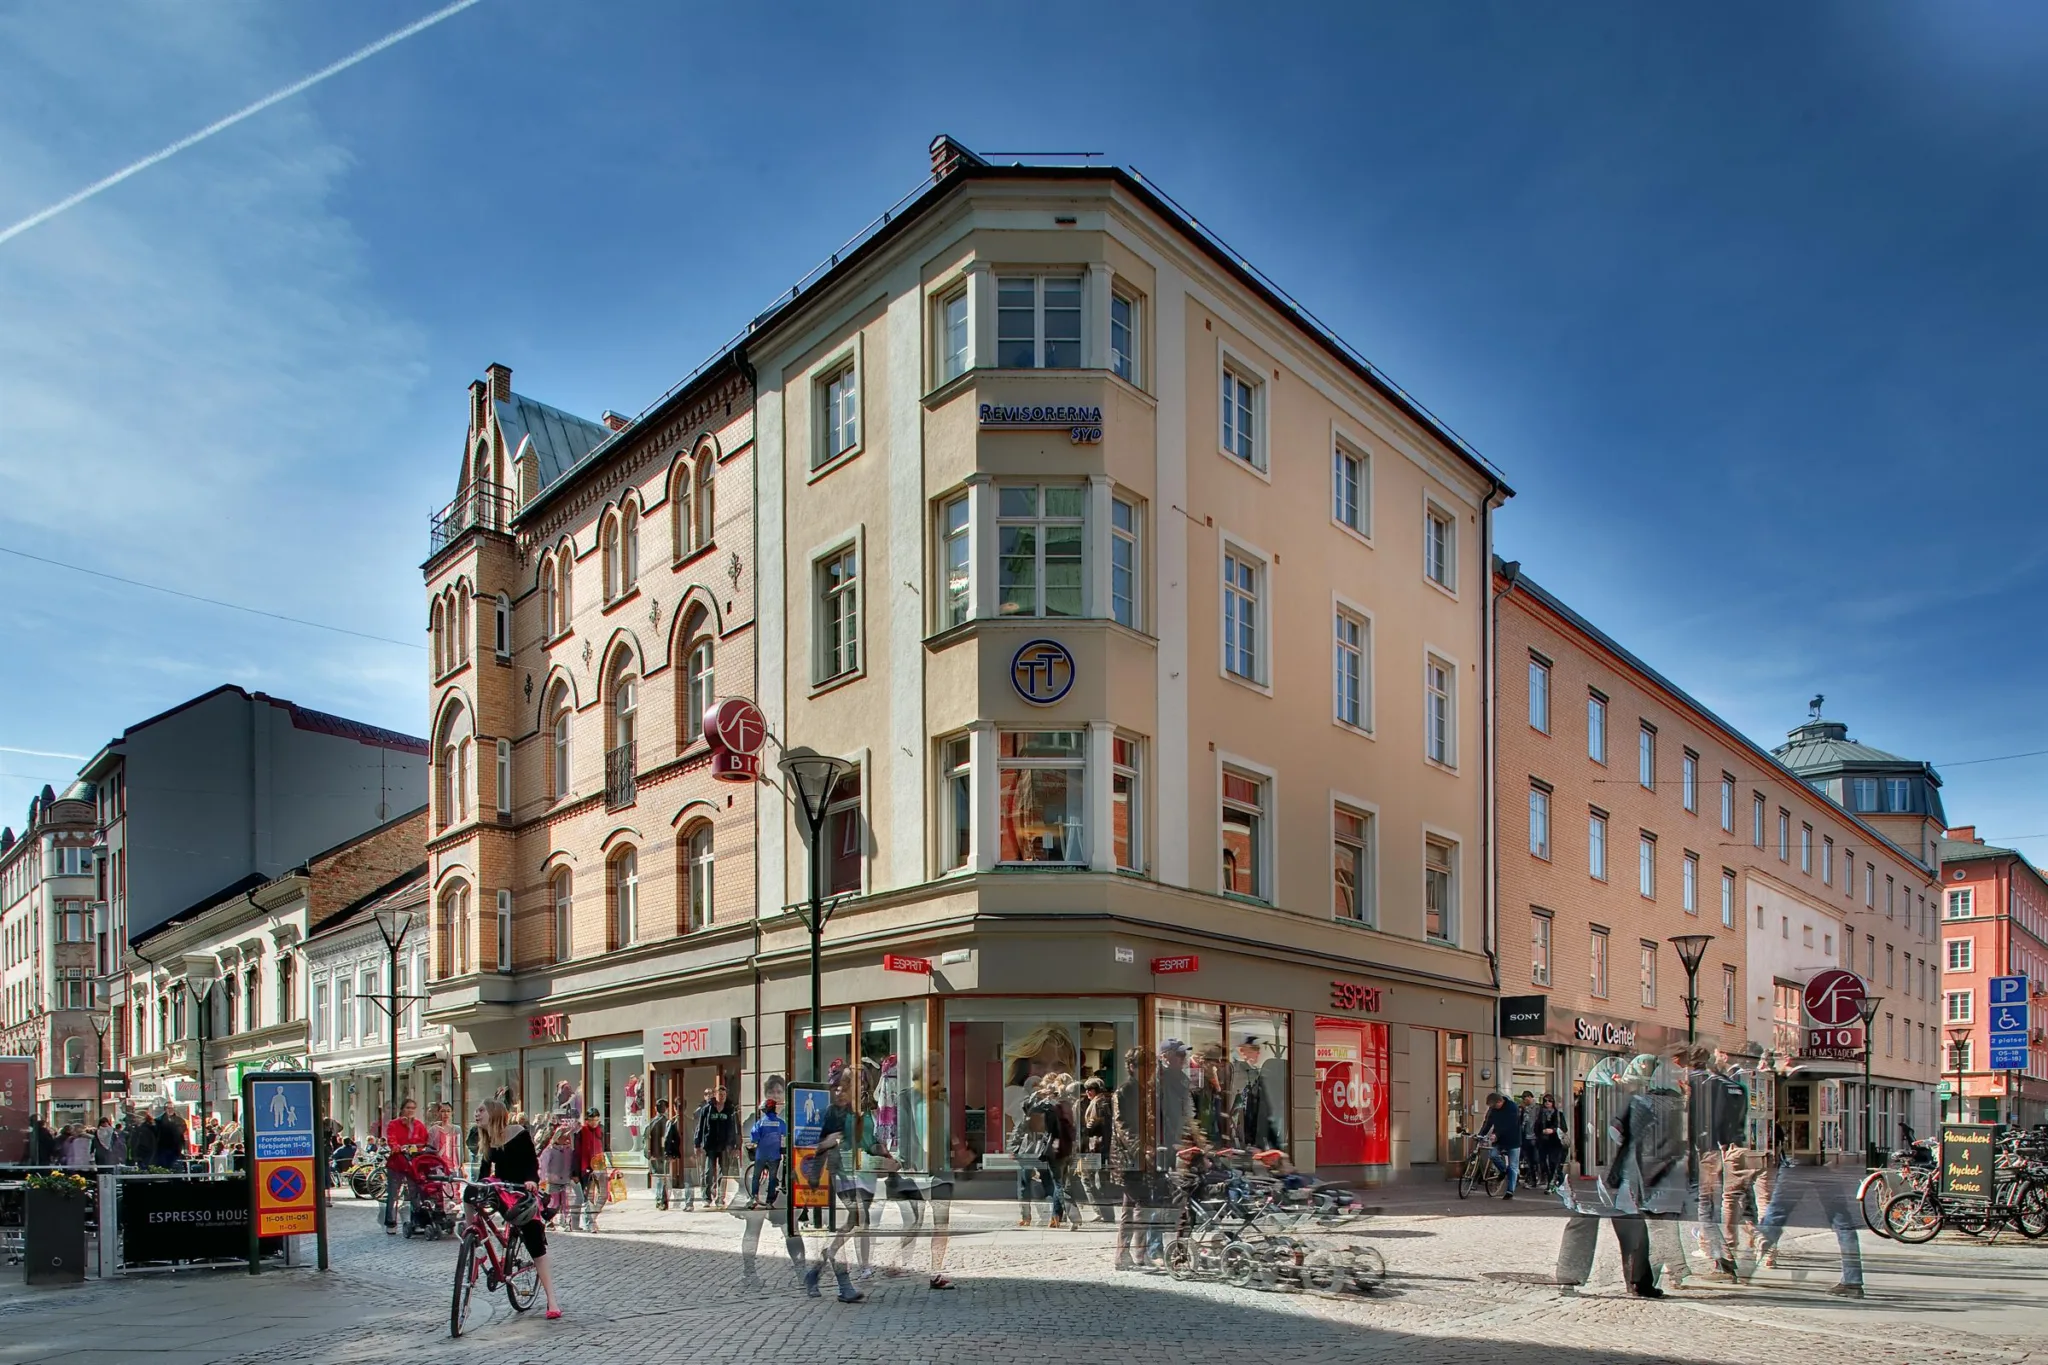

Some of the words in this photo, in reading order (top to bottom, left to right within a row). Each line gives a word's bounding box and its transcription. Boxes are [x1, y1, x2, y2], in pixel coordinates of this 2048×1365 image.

[979, 404, 1102, 420] REVISORERNA
[1071, 427, 1102, 440] SYD
[1019, 653, 1063, 694] TT
[893, 957, 924, 971] ESPRIT
[1159, 958, 1191, 971] ESPRIT
[1333, 981, 1383, 1013] ESPRIT
[2000, 979, 2019, 1002] P
[1509, 1013, 1540, 1021] SONY
[527, 1013, 564, 1039] ESPRIT
[1577, 1017, 1603, 1046] Sony
[1605, 1022, 1636, 1046] Center
[663, 1028, 709, 1055] ESPRIT
[1810, 1030, 1852, 1046] BIO
[1998, 1037, 2027, 1045] platser
[139, 1082, 158, 1093] flash
[1333, 1072, 1372, 1109] edc
[261, 1135, 307, 1143] Fordonstrafik
[1944, 1130, 1991, 1144] Skomakeri
[258, 1142, 292, 1150] förbjuden
[1962, 1149, 1970, 1161] &
[1949, 1179, 1981, 1192] Service
[149, 1210, 212, 1223] ESPRESSO
